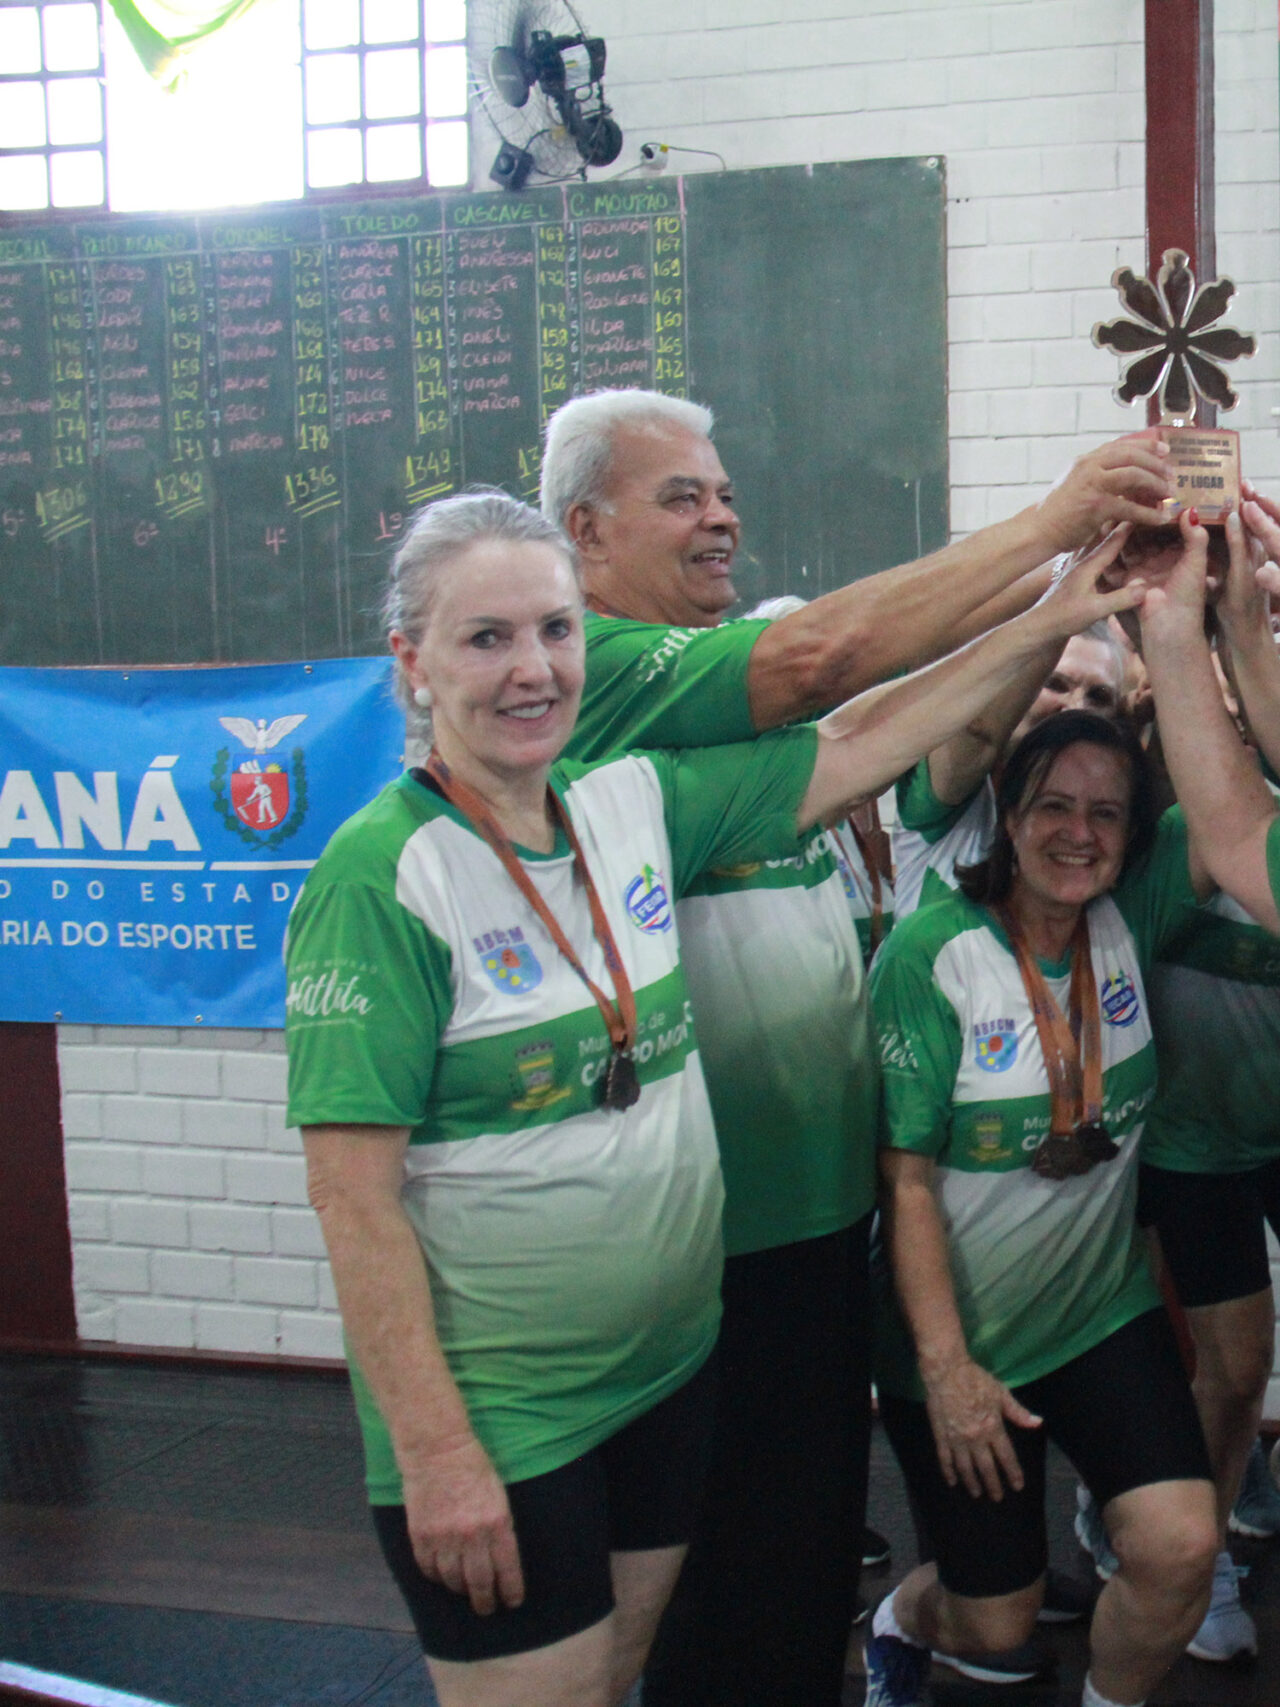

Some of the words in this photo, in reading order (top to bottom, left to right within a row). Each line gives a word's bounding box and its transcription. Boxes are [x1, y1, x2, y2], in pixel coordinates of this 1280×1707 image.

[340, 213, 419, 235] TOLEDO
[454, 204, 549, 225] CASCAVEL
[52, 881, 105, 900] DO
[140, 883, 291, 903] ESTAD
[0, 920, 53, 945] RIA
[61, 921, 109, 947] DO
[118, 922, 257, 950] ESPORTE
